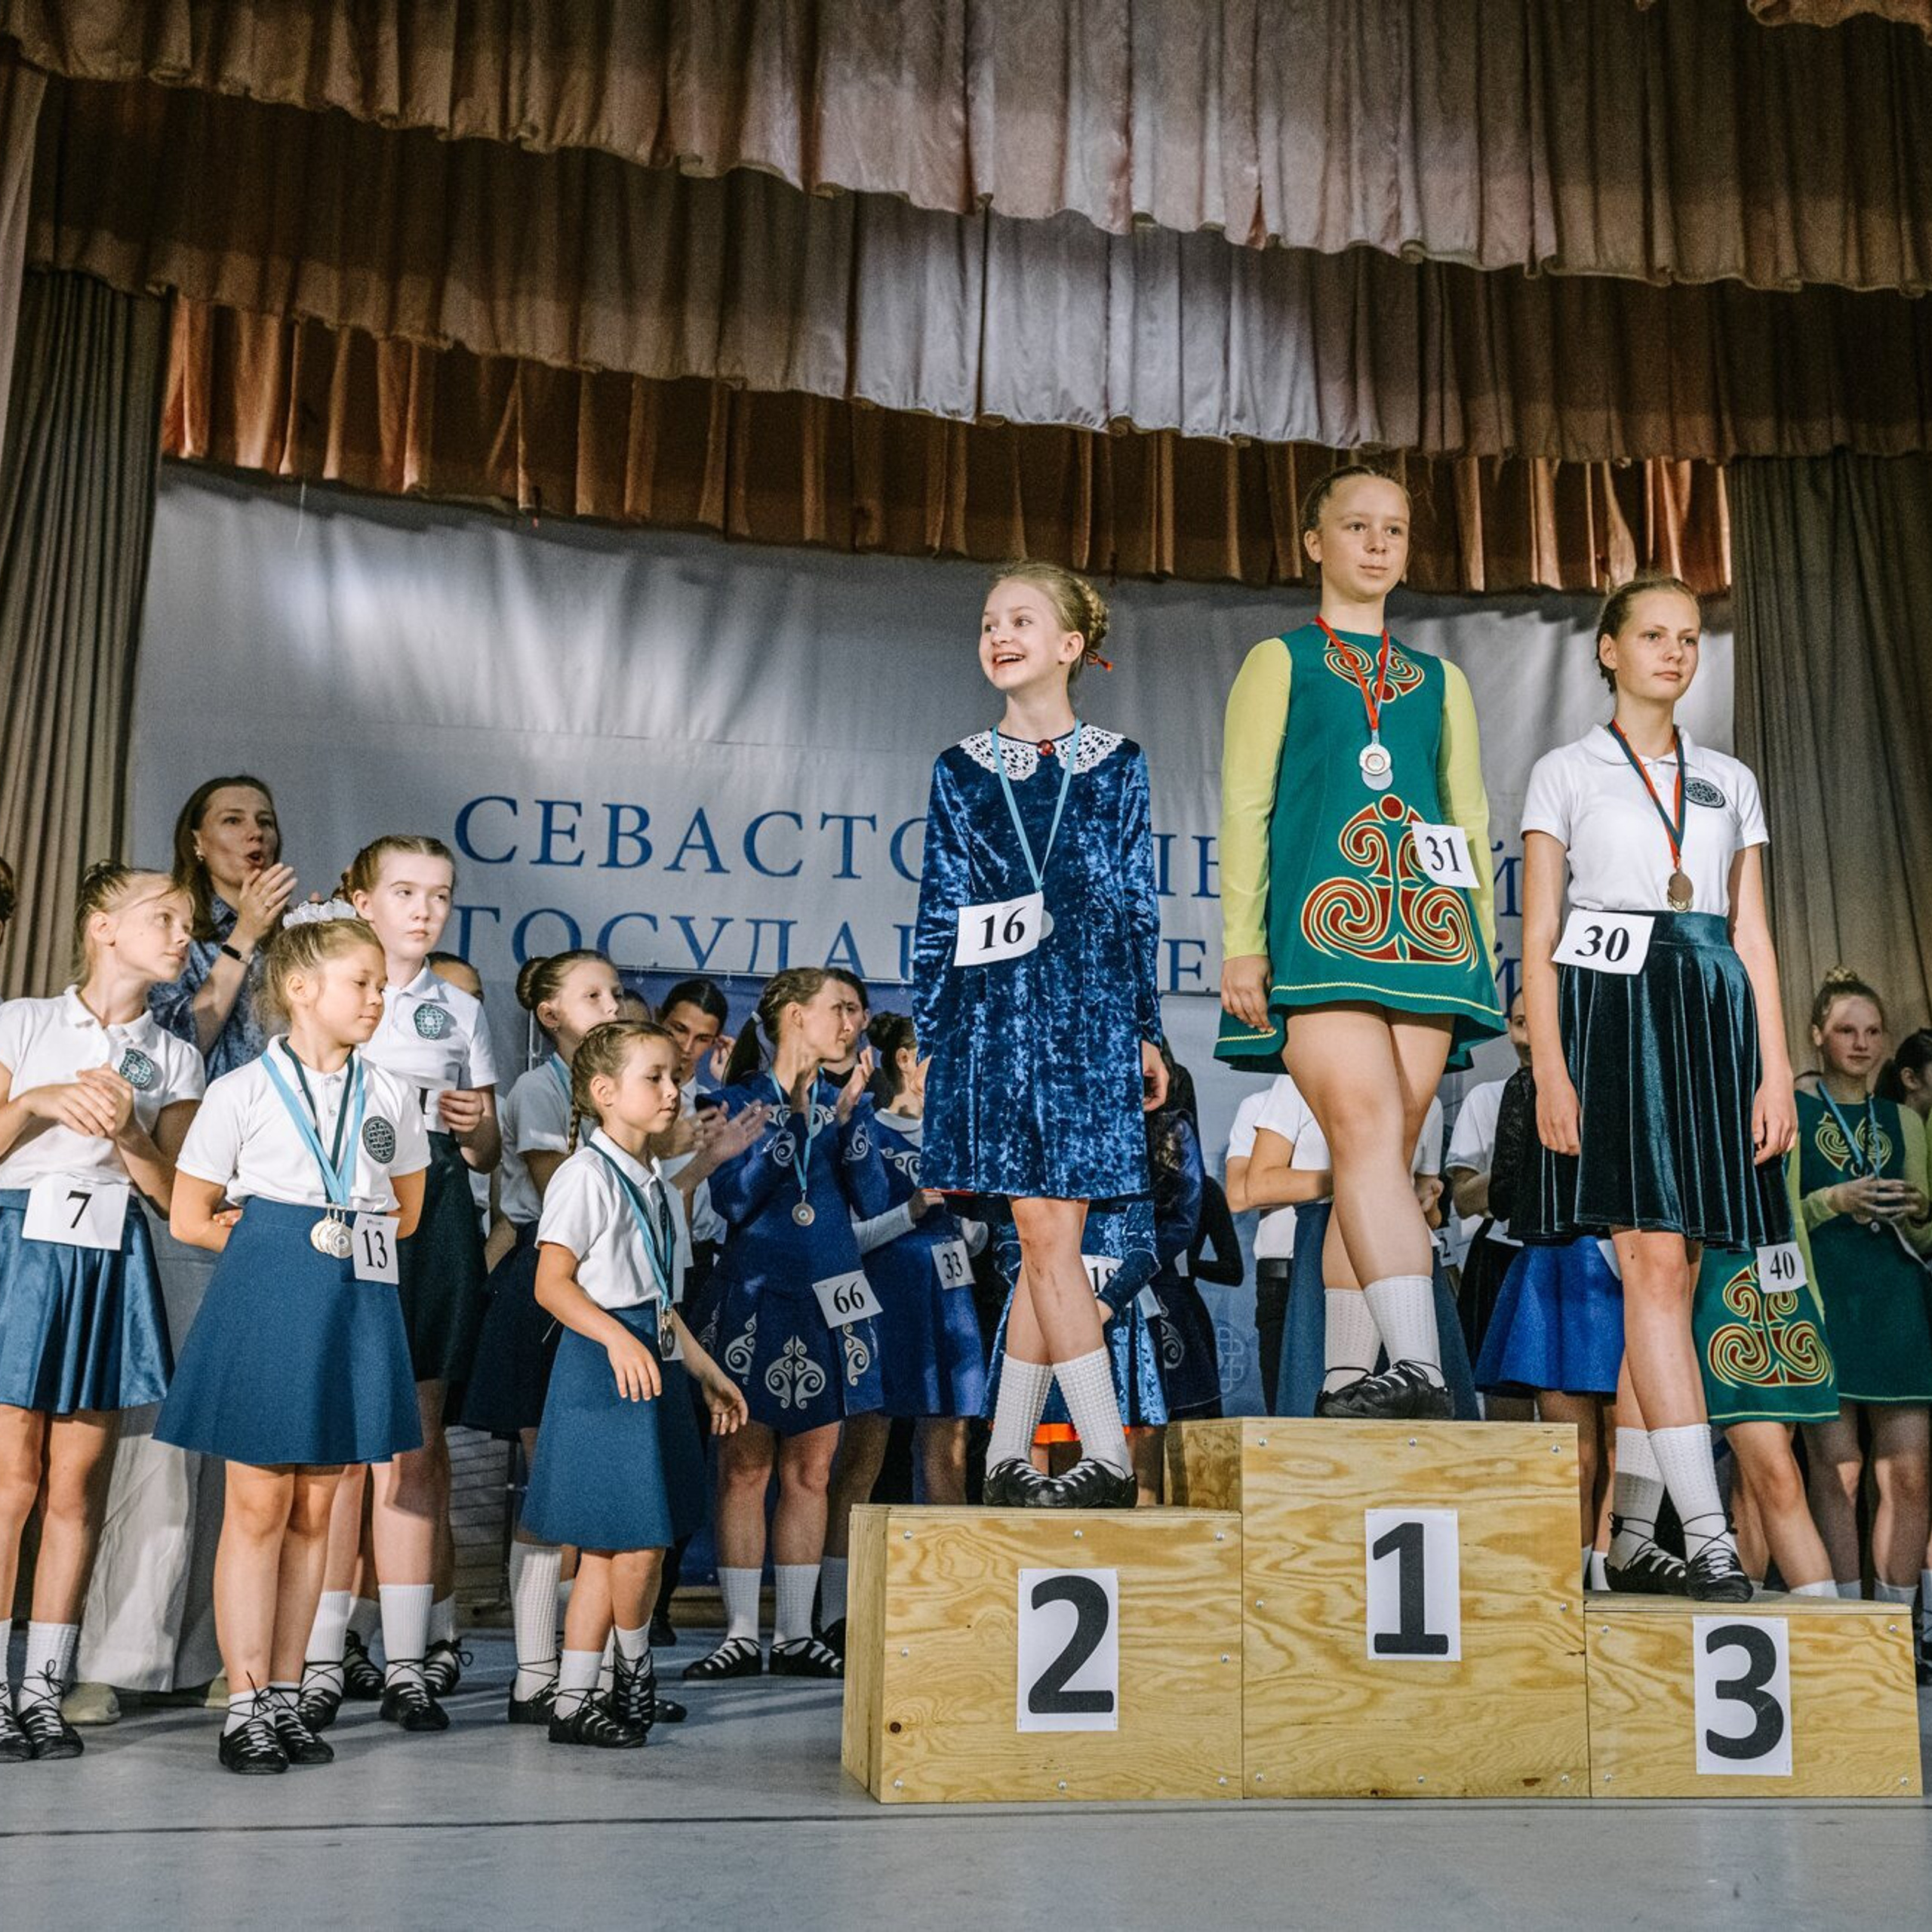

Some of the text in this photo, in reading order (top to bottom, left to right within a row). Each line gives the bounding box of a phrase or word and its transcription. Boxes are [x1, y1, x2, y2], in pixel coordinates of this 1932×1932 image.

[1424, 835, 1463, 873] 31
[979, 906, 1026, 951] 16
[1574, 924, 1629, 962] 30
[66, 1189, 92, 1229] 7
[362, 1228, 388, 1269] 13
[942, 1251, 963, 1280] 33
[1770, 1250, 1795, 1281] 40
[833, 1280, 866, 1315] 66
[1372, 1521, 1449, 1655] 1
[1027, 1574, 1115, 1715] 2
[1705, 1623, 1785, 1761] 3
